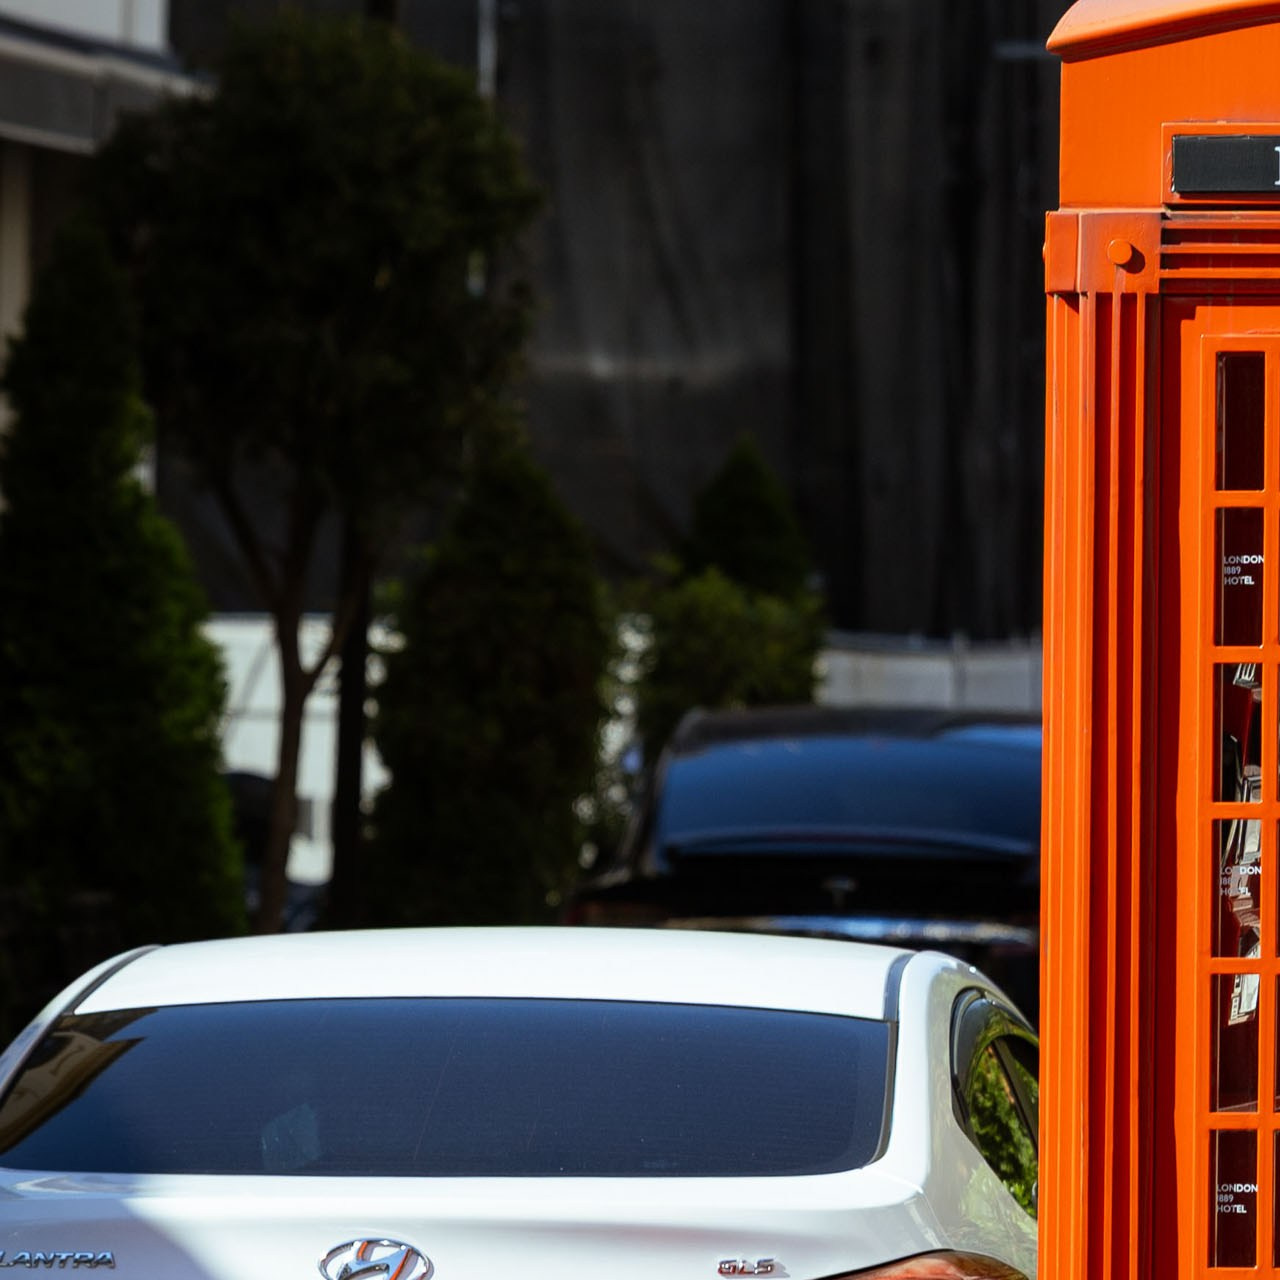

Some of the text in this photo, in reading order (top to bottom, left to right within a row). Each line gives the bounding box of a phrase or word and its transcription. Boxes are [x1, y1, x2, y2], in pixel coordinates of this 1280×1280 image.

[1224, 555, 1264, 564] LONDON
[1224, 576, 1255, 585] HOTEL
[1220, 866, 1262, 875] LODON
[1217, 1184, 1258, 1193] LONDON
